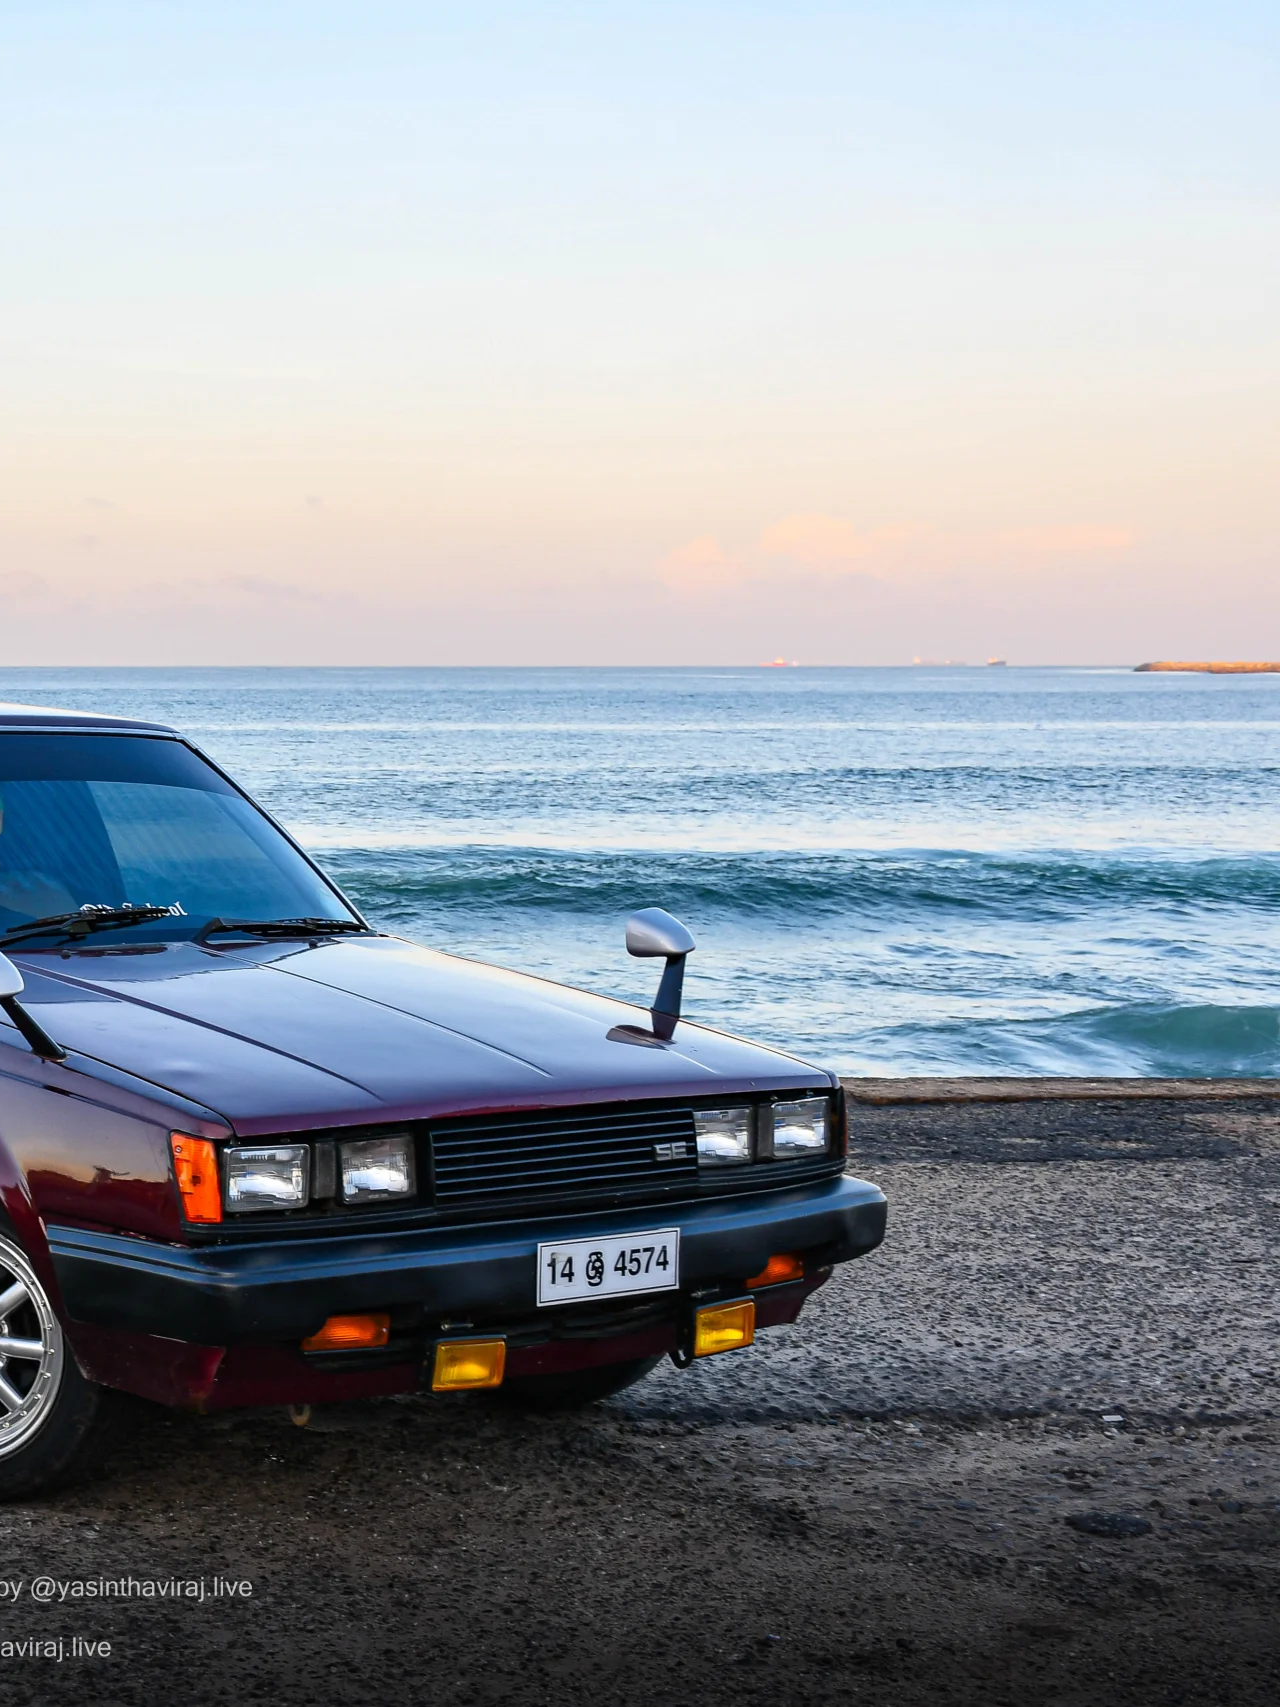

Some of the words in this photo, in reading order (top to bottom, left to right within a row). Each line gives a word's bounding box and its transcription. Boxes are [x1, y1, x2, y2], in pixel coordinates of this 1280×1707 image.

[653, 1141, 687, 1161] SE
[547, 1256, 575, 1285] 14
[614, 1245, 669, 1276] 4574
